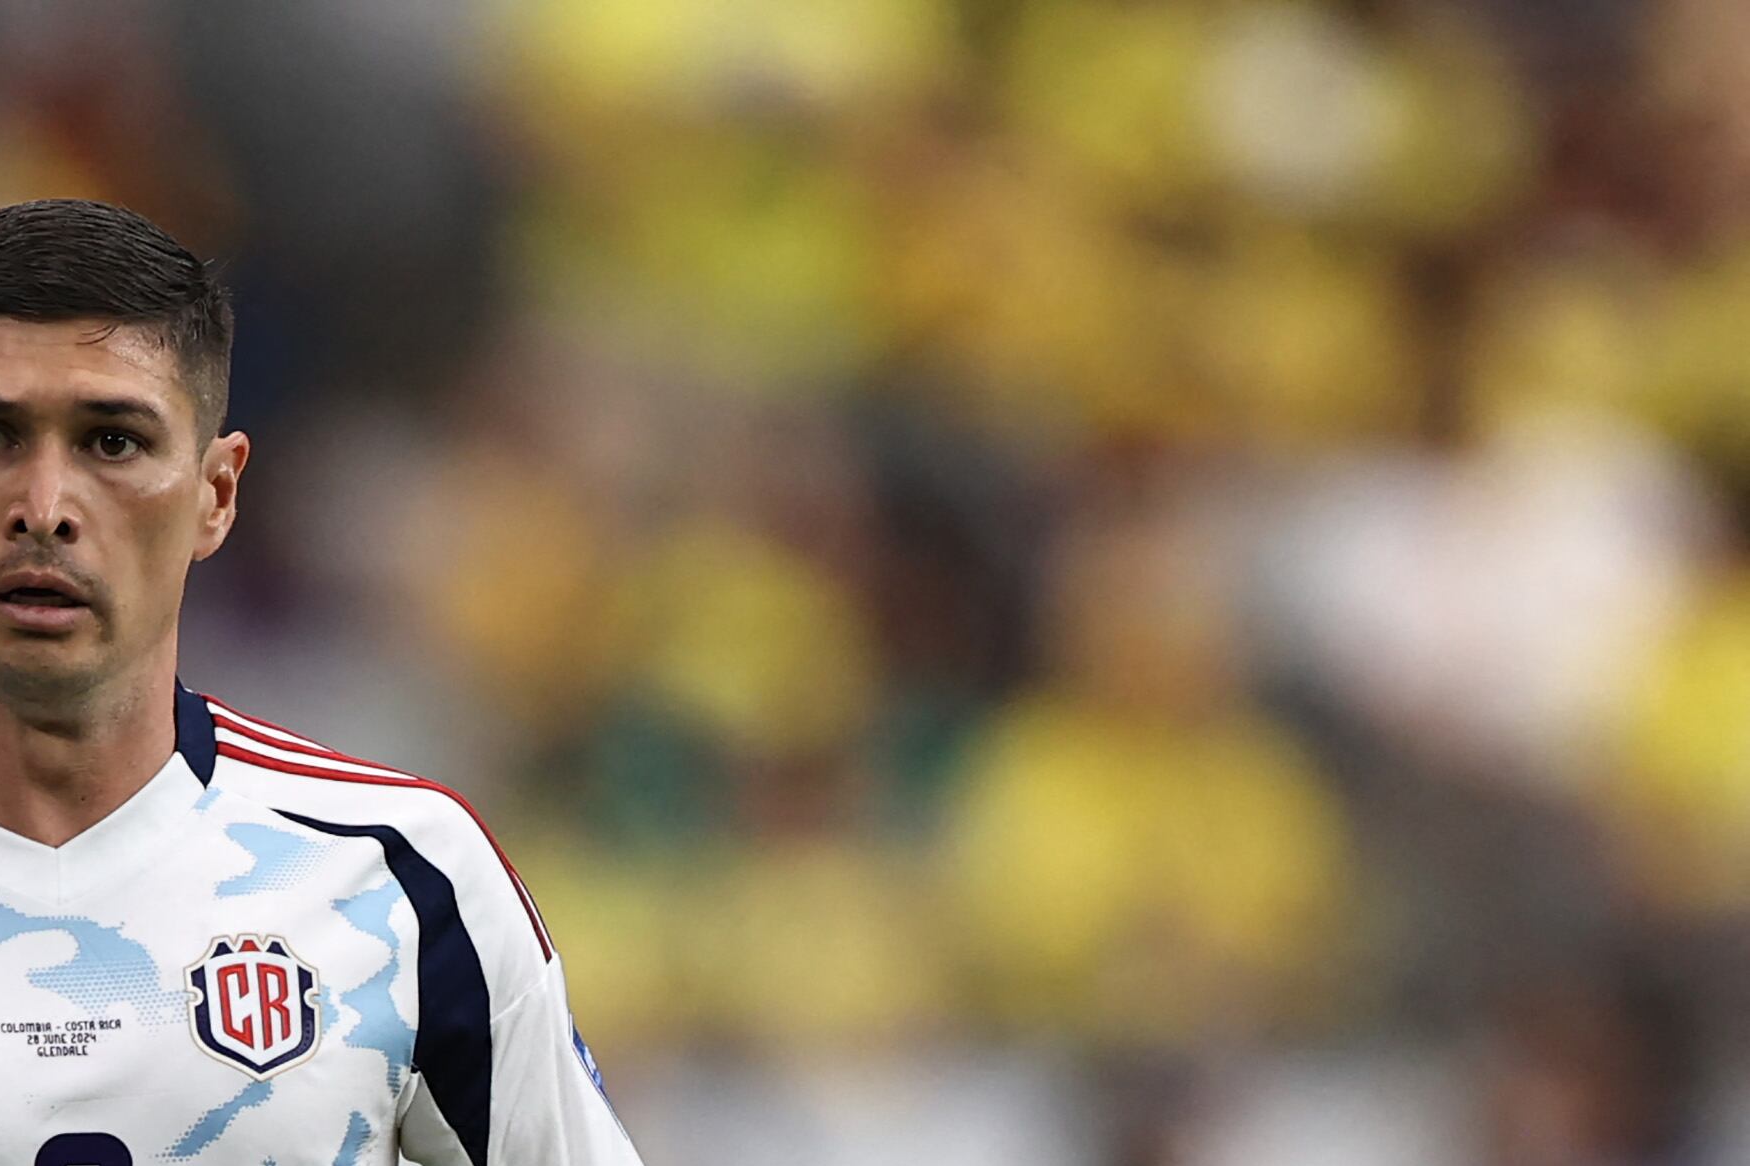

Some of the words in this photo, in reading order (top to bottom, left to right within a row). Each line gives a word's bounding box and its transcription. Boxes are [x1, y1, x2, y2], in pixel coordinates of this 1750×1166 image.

[217, 963, 291, 1050] CR
[0, 1022, 52, 1033] COLOMBIA
[65, 1020, 96, 1031] COSTA
[98, 1019, 122, 1030] RICA
[42, 1033, 67, 1044] JUNE
[70, 1032, 97, 1043] 2024
[36, 1045, 89, 1057] GLENDALE
